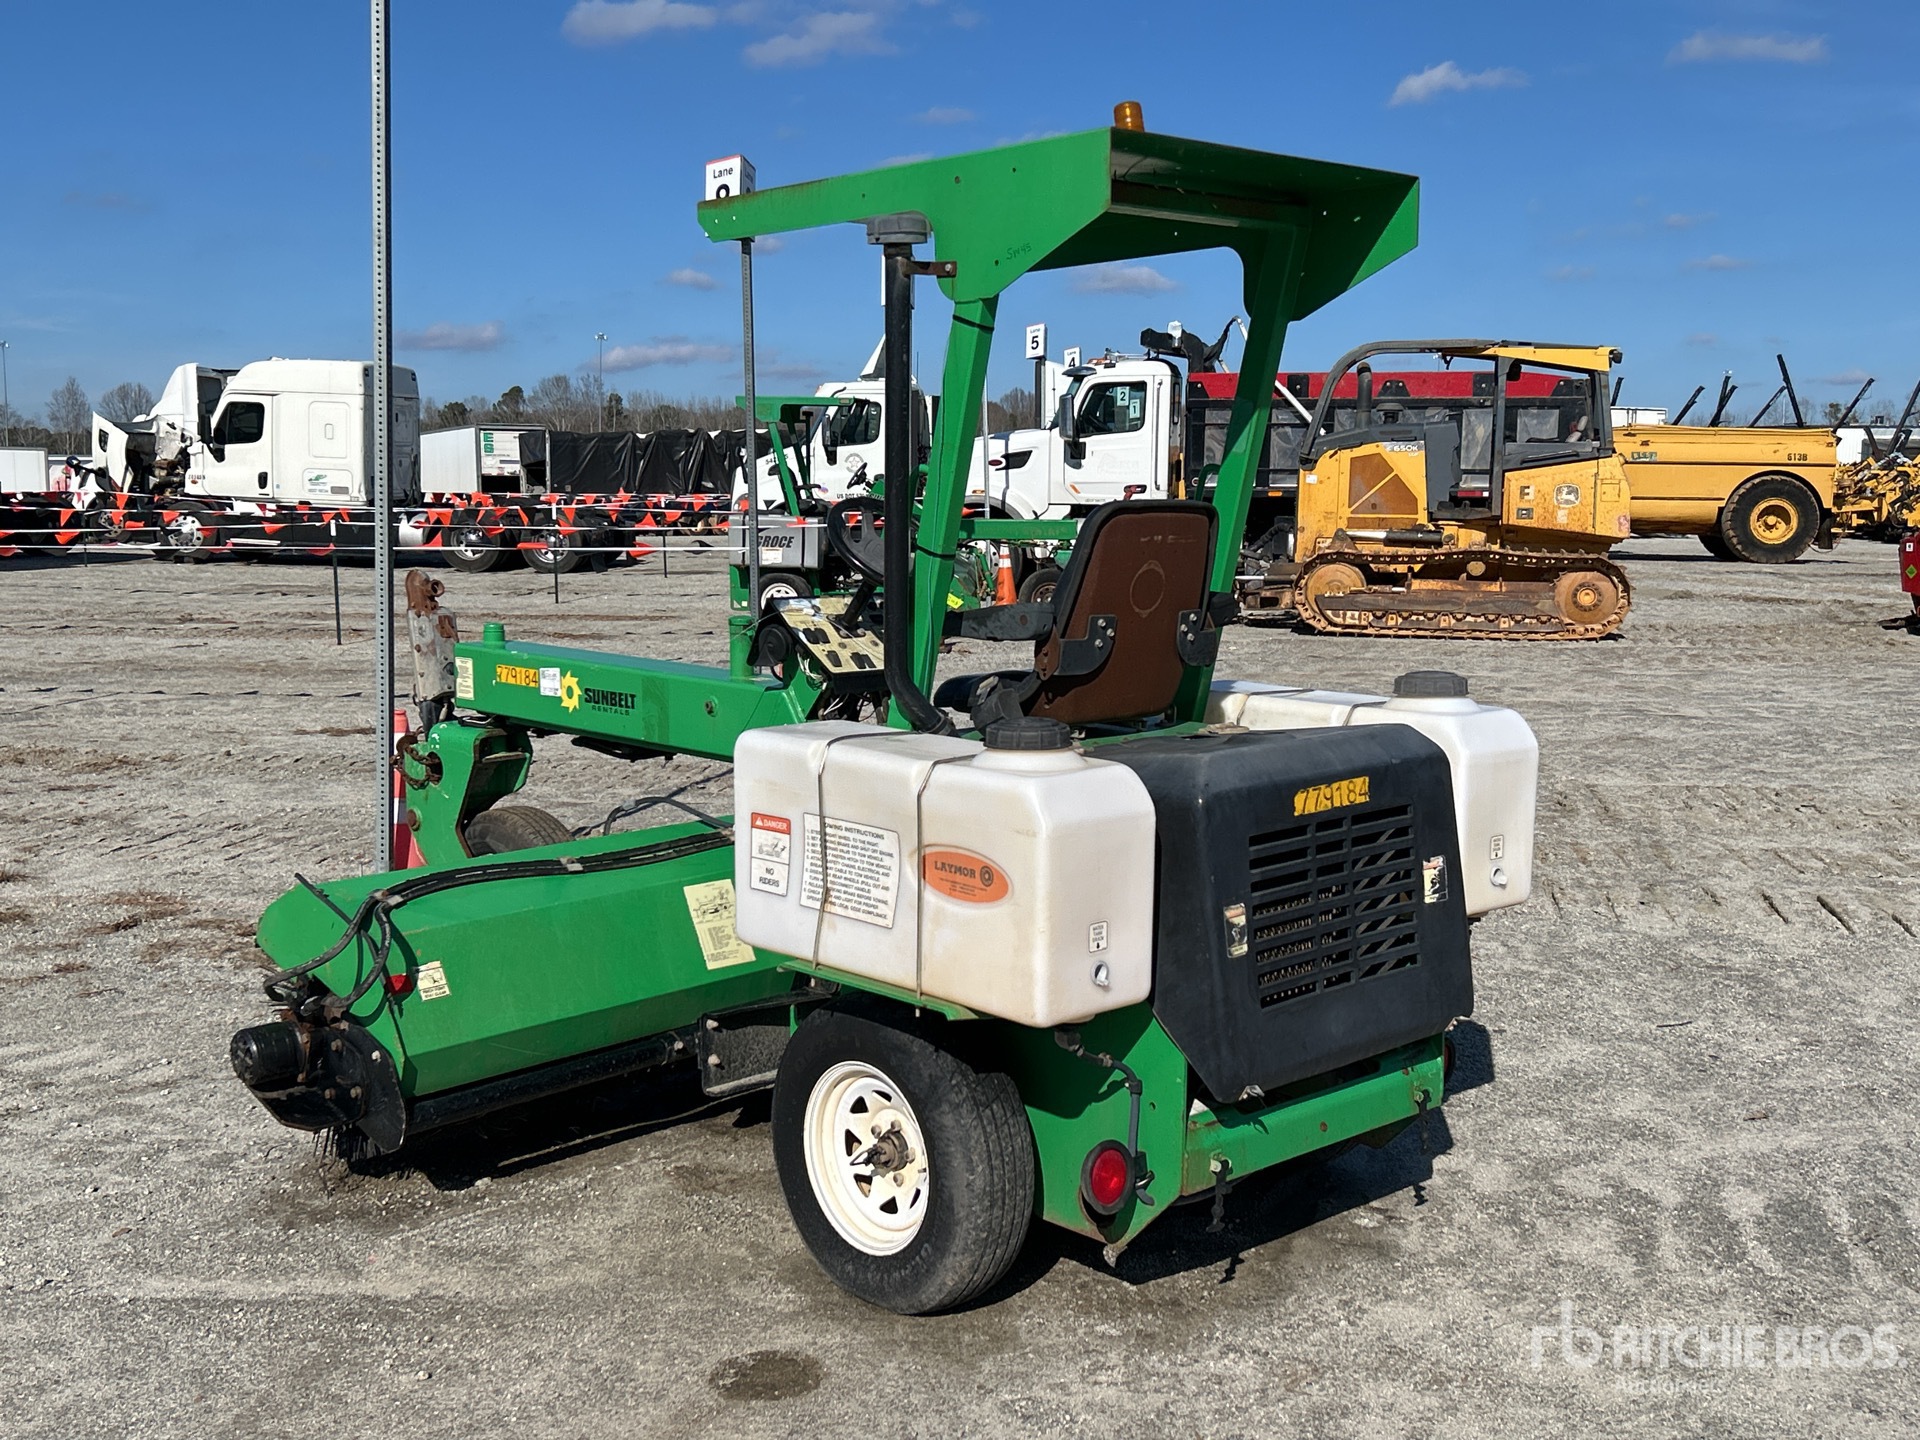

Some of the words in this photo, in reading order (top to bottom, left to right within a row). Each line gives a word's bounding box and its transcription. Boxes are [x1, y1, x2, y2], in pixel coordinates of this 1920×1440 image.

[713, 167, 734, 179] Lane
[1031, 335, 1039, 350] 5
[1068, 357, 1076, 368] 4
[1120, 391, 1126, 402] 2
[1132, 405, 1137, 414] 1
[498, 665, 538, 687] 779184
[584, 688, 636, 710] SUNBELT
[592, 704, 630, 716] RENTALS
[1300, 778, 1370, 814] 779184
[764, 818, 788, 831] DANGER
[844, 826, 884, 840] INSTRUCTIONS
[766, 867, 775, 876] NO
[934, 860, 976, 879] LAYMOR
[759, 876, 780, 888] RIDERS
